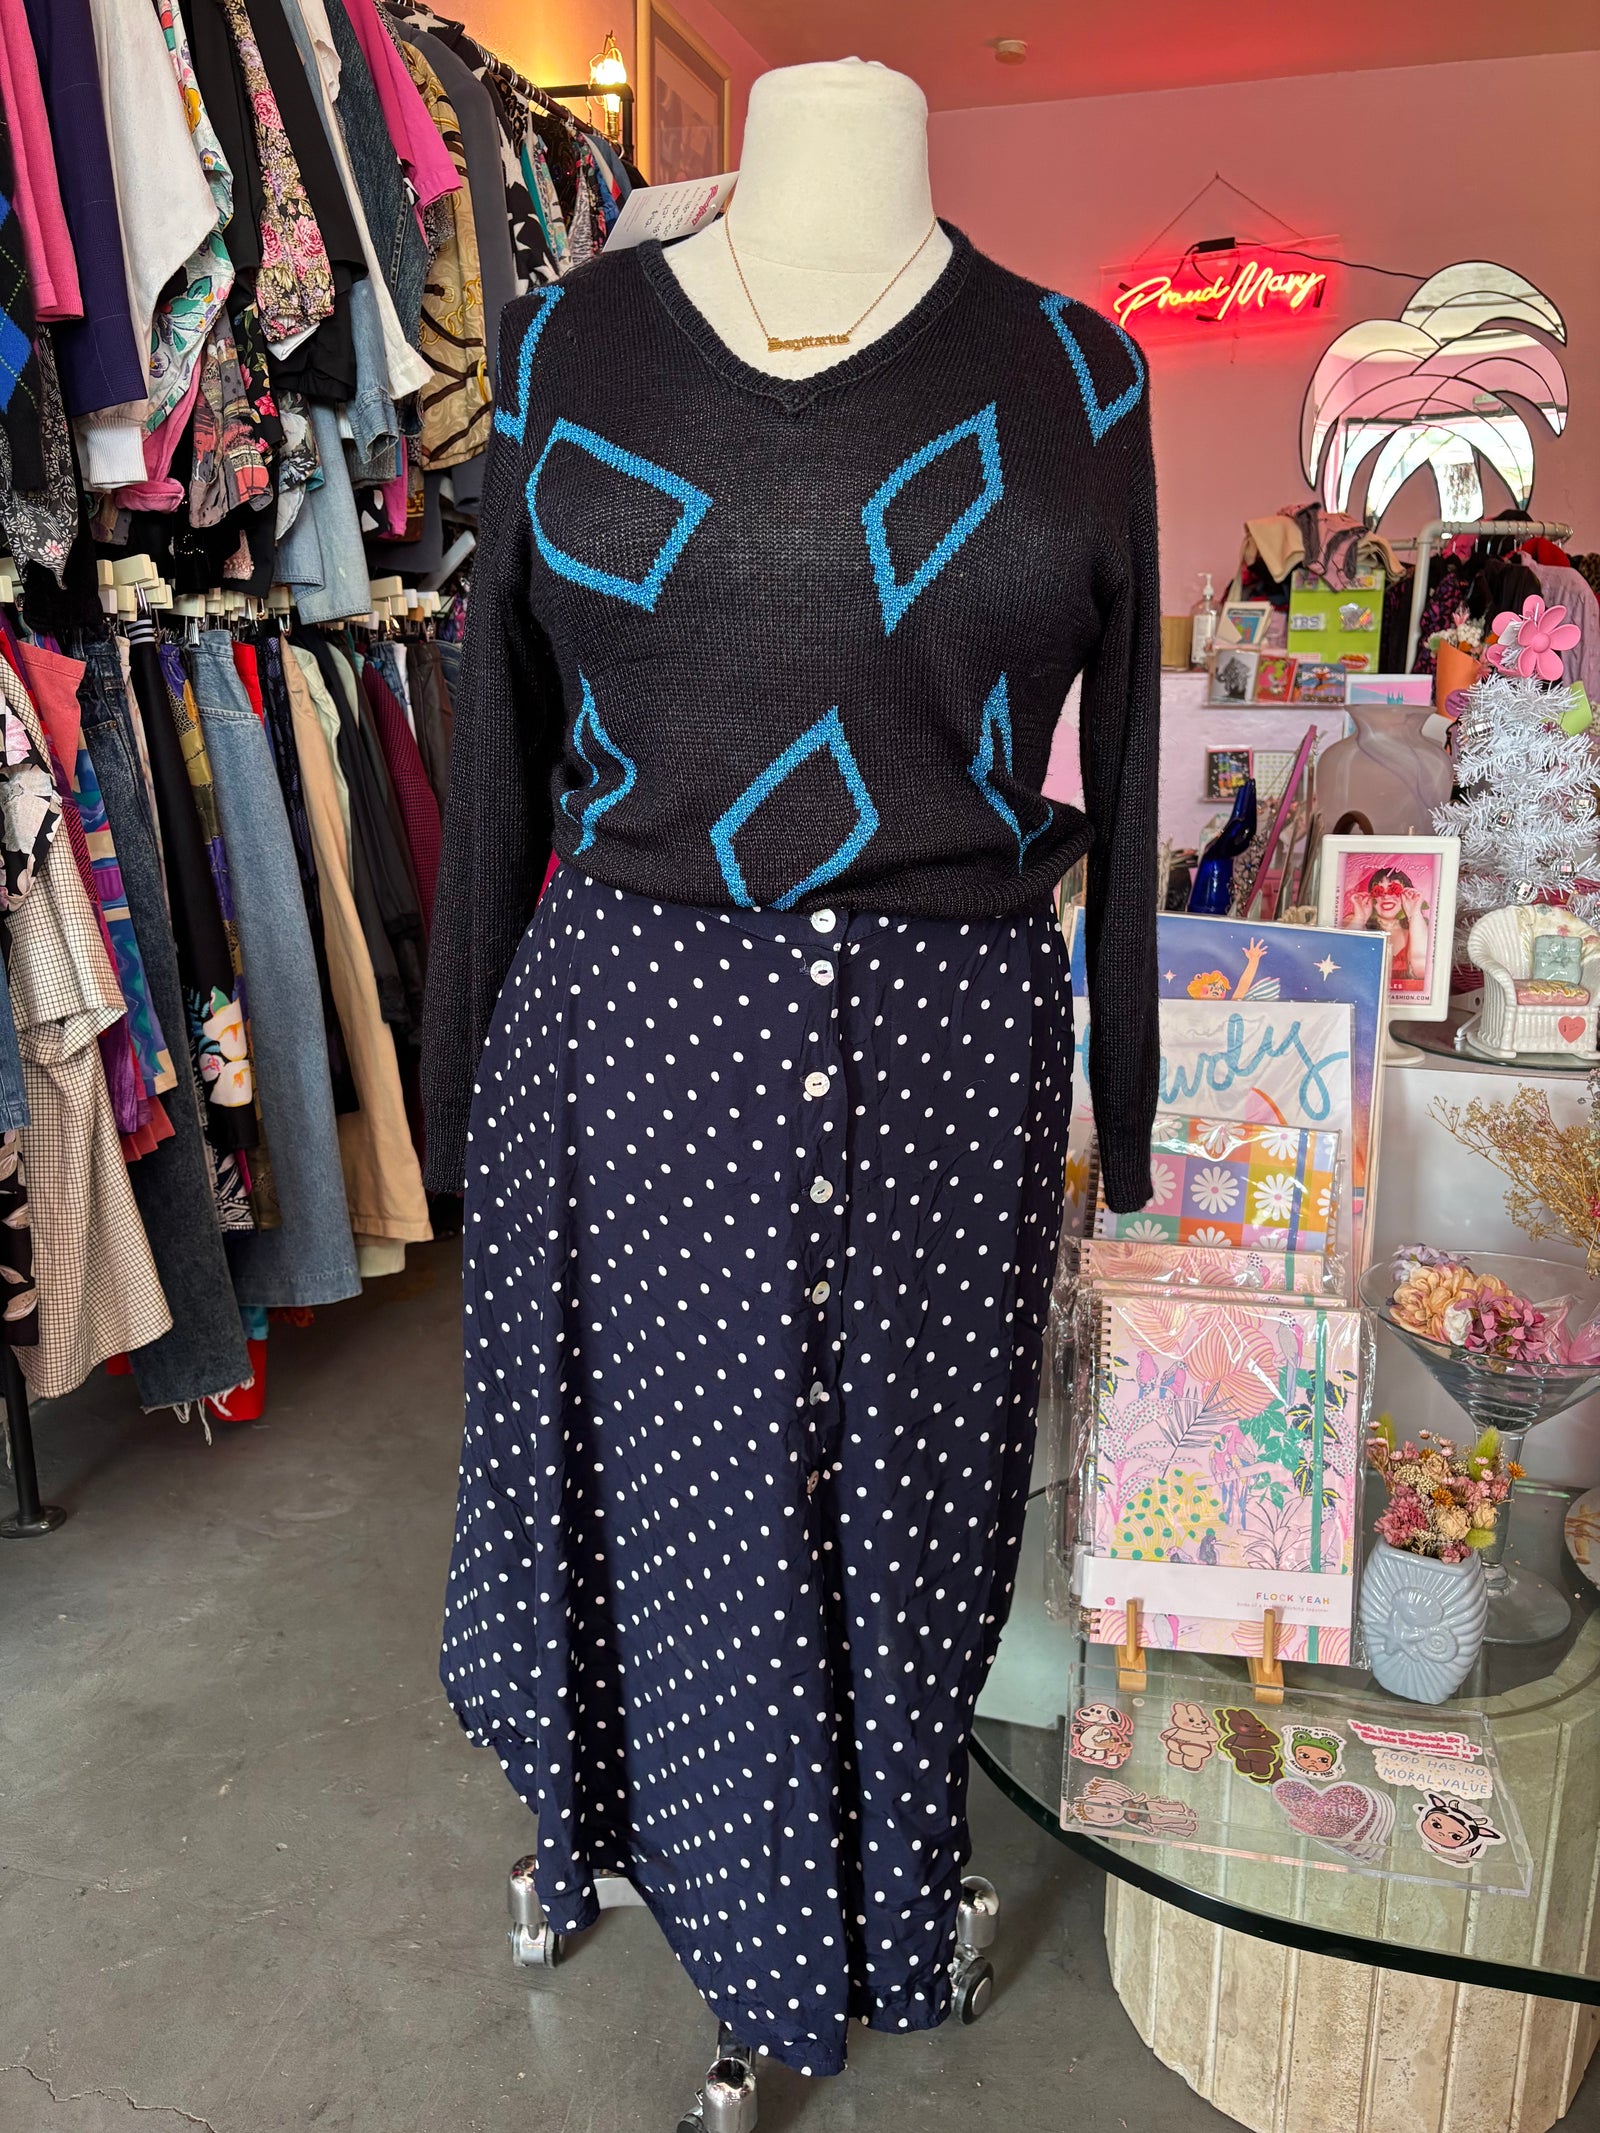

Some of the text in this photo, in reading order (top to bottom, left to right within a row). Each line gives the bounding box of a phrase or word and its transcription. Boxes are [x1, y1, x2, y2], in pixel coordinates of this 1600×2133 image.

[1113, 261, 1326, 328] Proud Mary
[1256, 1592, 1330, 1605] FLOCK YEAH
[1382, 1751, 1420, 1764] FOOD
[1427, 1758, 1456, 1771] HAS
[1464, 1766, 1485, 1777] NO
[1383, 1768, 1487, 1795] MORAL VALUE
